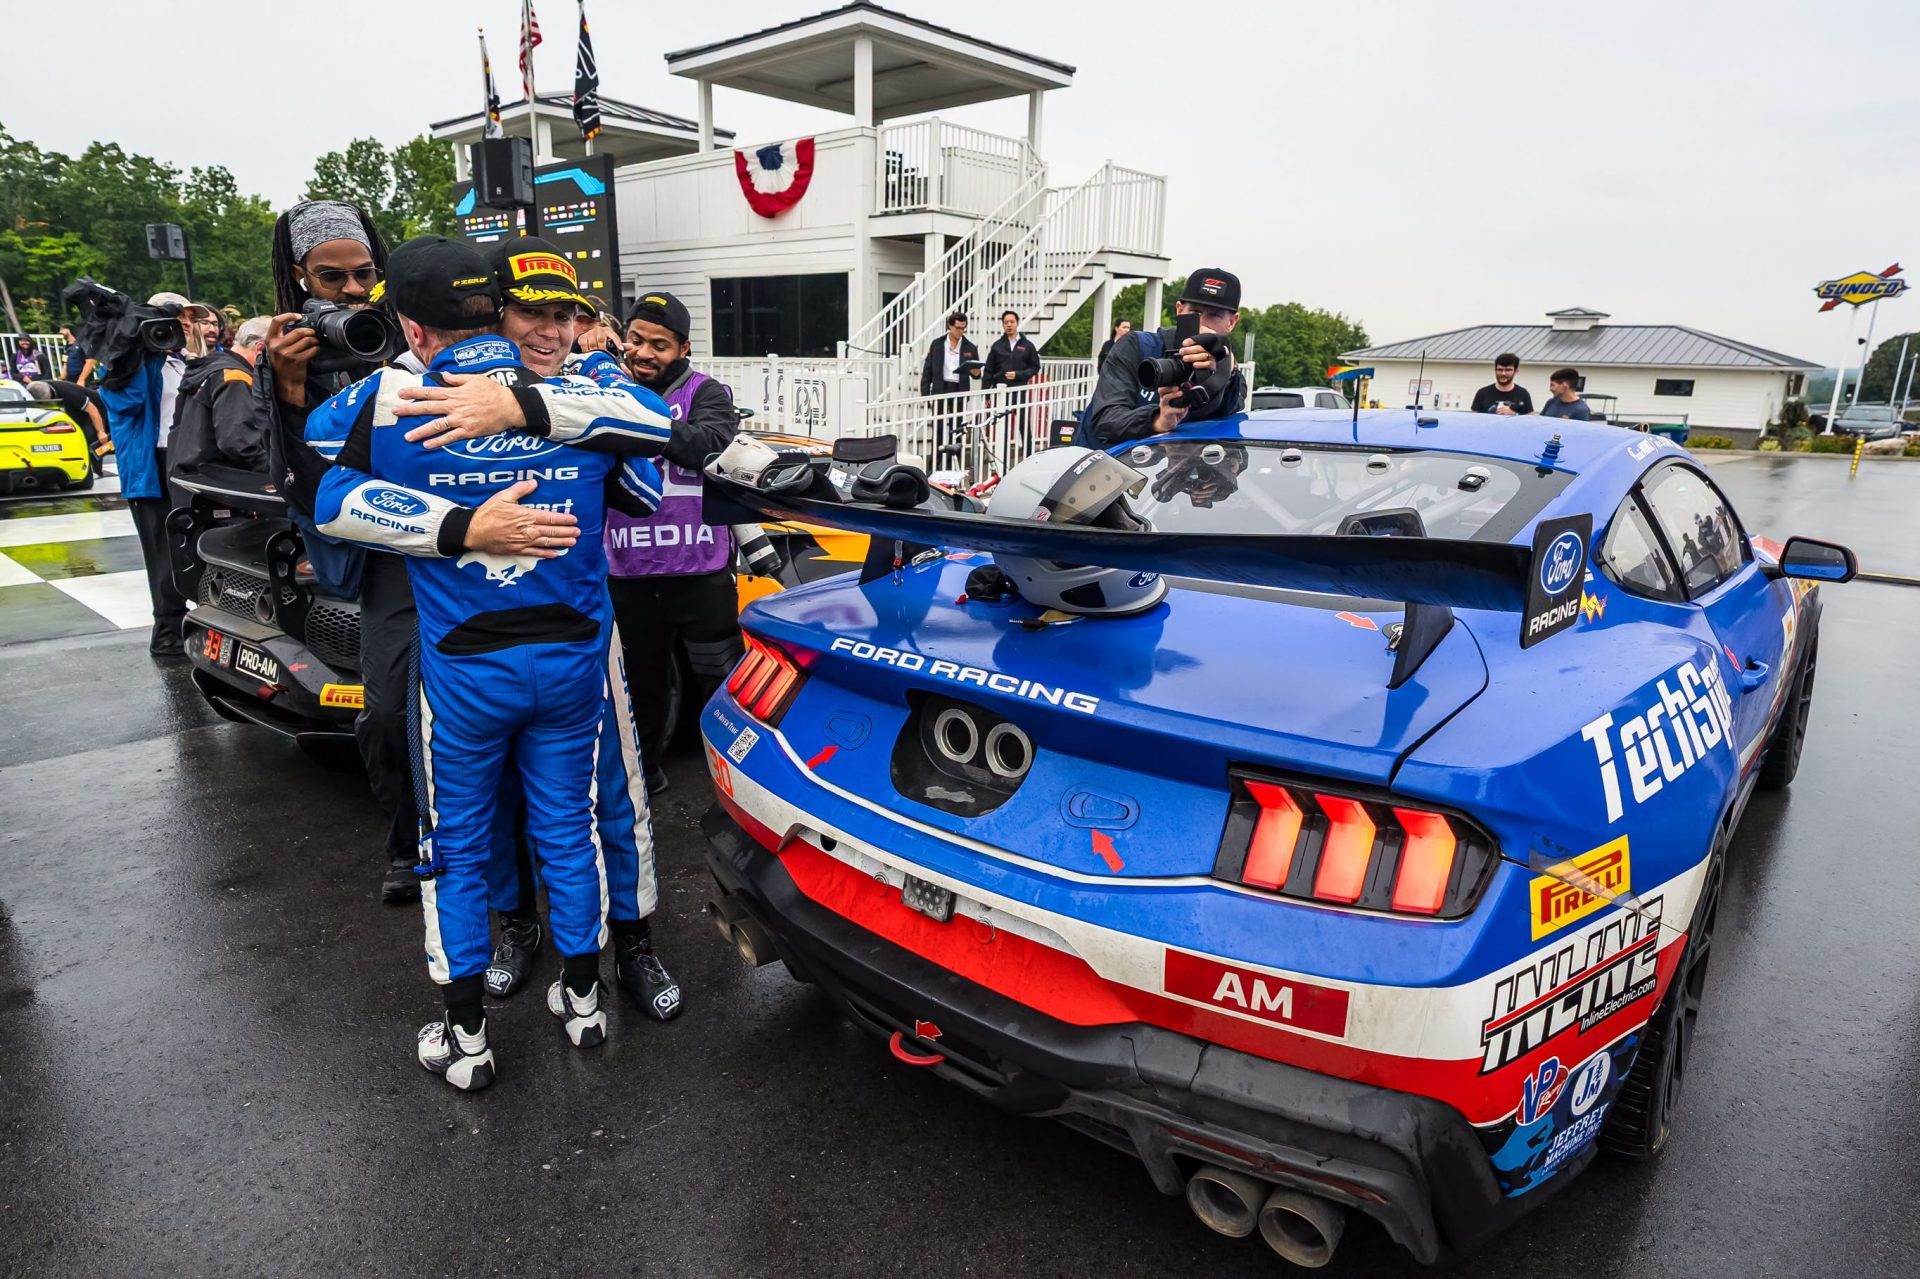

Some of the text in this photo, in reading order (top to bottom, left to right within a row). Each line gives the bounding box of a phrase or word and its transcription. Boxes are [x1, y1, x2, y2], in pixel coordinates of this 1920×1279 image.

[1821, 282, 1900, 295] SUNOCO
[489, 371, 518, 387] MP
[33, 444, 61, 452] SILVER
[465, 432, 545, 453] Ford
[429, 467, 579, 486] RACING
[372, 490, 417, 514] Ford
[350, 508, 426, 534] RACING
[610, 524, 714, 549] MEDIA
[1547, 541, 1577, 585] Ford
[1528, 598, 1578, 636] RACING
[203, 628, 222, 661] 33
[240, 648, 278, 679] PRO-AM
[831, 637, 1100, 715] FORD RACING
[326, 688, 364, 704] PIRE
[710, 746, 734, 798] 30
[1541, 850, 1623, 924] PIRELLI
[657, 987, 680, 1007] OM
[1212, 971, 1293, 1020] AM
[1481, 896, 1663, 1076] INLINE
[1580, 978, 1656, 1031] InlineElectric.com
[1523, 1056, 1560, 1125] VP
[1549, 1102, 1609, 1153] JEFFREY
